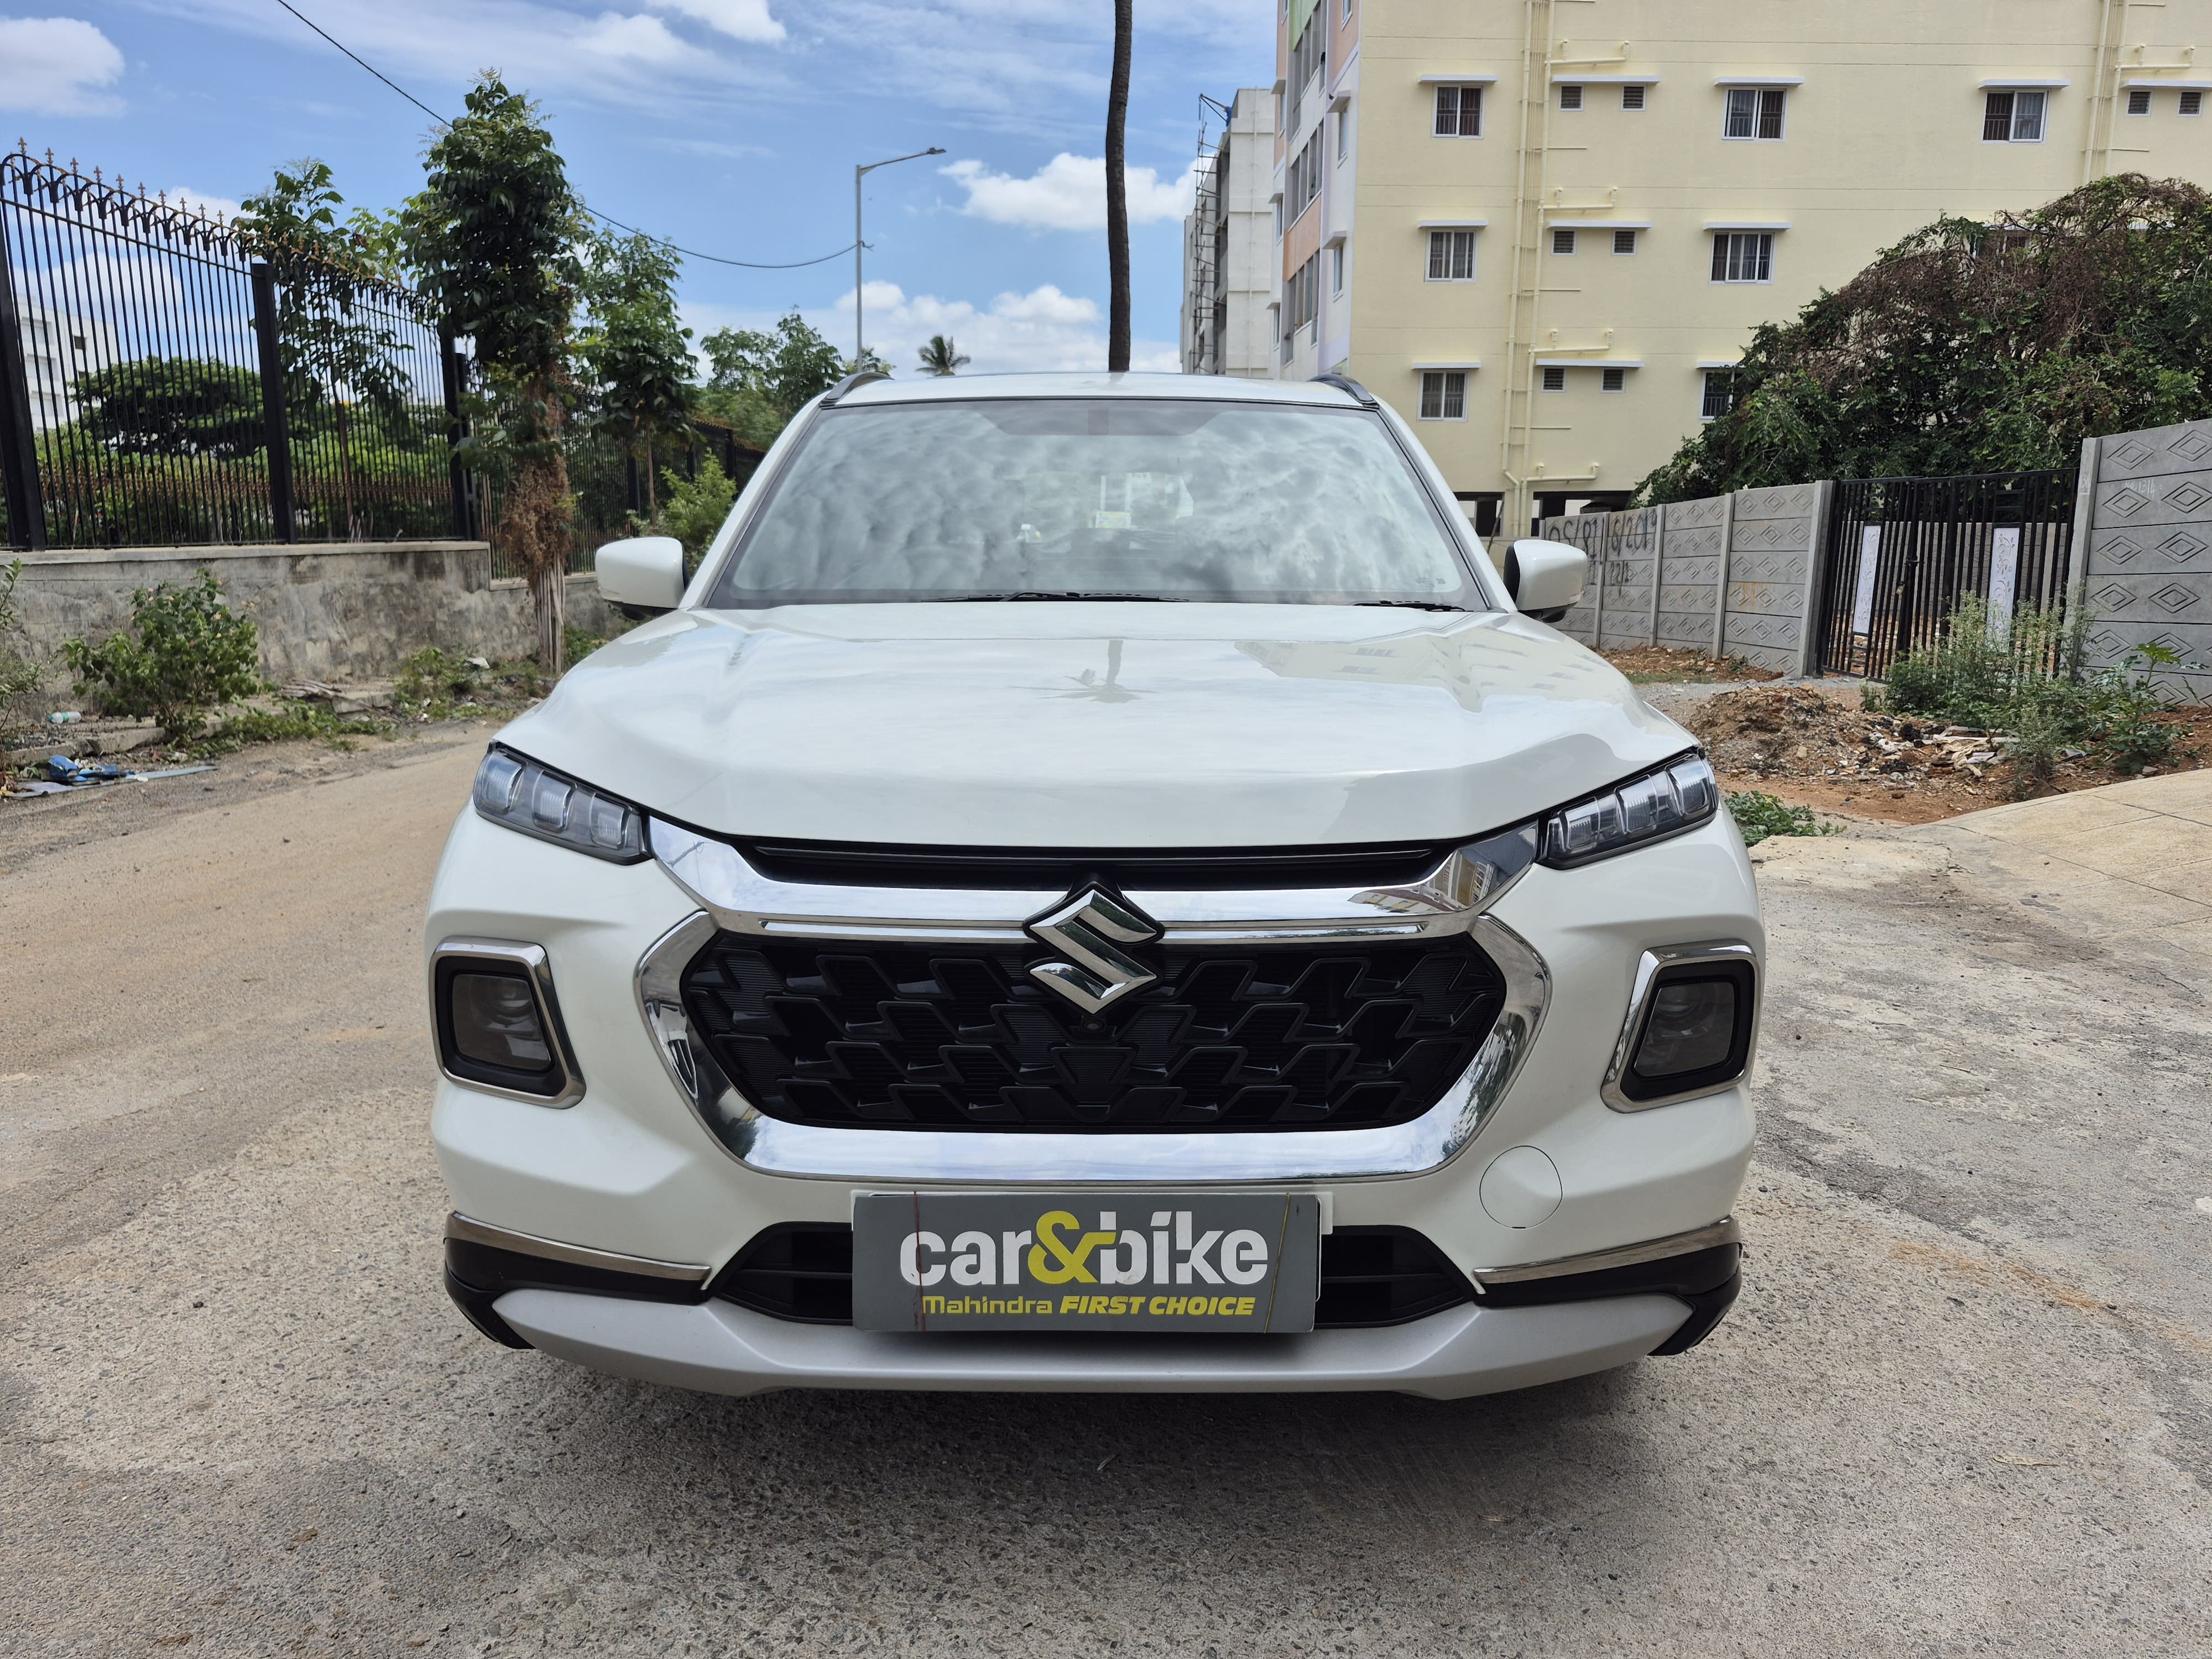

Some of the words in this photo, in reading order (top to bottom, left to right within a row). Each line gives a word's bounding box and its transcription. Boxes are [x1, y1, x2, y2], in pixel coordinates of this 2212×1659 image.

[900, 1210, 1268, 1286] car&bike
[922, 1295, 1053, 1314] Mahindra
[1059, 1295, 1146, 1314] FIRST
[1148, 1296, 1256, 1316] CHOICE
